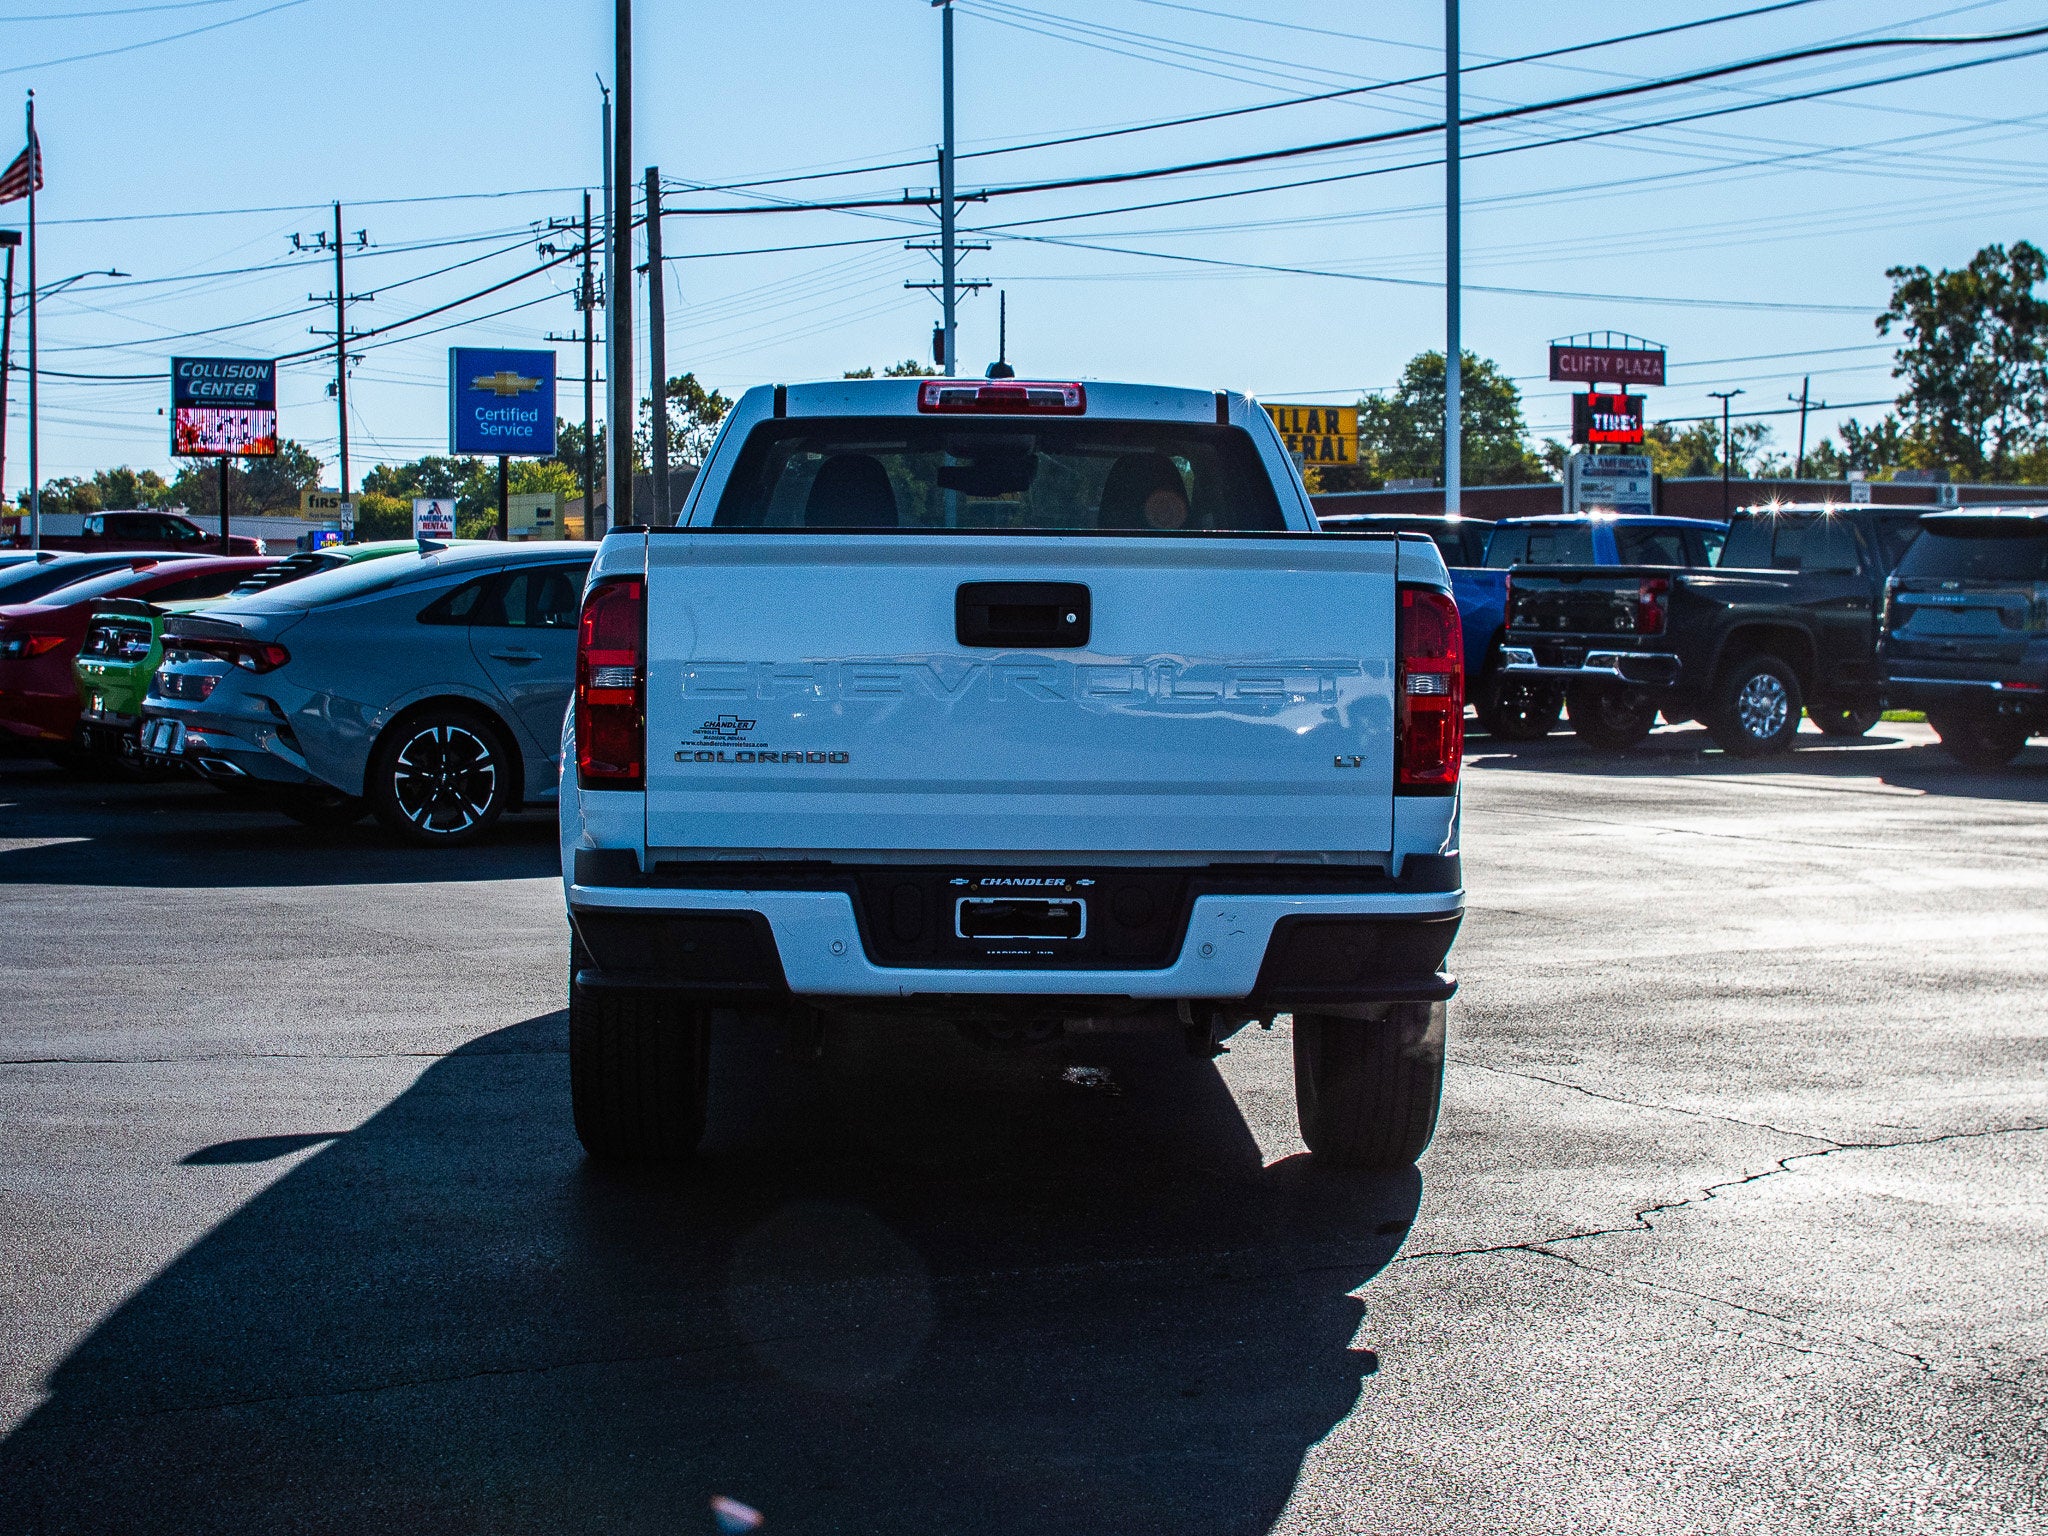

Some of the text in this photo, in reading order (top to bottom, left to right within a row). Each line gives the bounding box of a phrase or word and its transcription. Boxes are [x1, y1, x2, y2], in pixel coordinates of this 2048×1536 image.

[179, 362, 269, 379] COLLISION
[1559, 354, 1662, 376] CLIFTY PLAZA
[188, 380, 257, 396] CENTER
[475, 407, 538, 422] Certified
[1264, 408, 1340, 434] LLAR
[480, 422, 533, 437] Service
[418, 514, 454, 522] AMERICAN
[422, 522, 449, 530] RENTAL
[681, 660, 1361, 703] CHEVROLET
[703, 720, 749, 729] CHANDLER
[674, 750, 1368, 768] COLORADO LT
[980, 878, 1066, 886] CHANDLER
